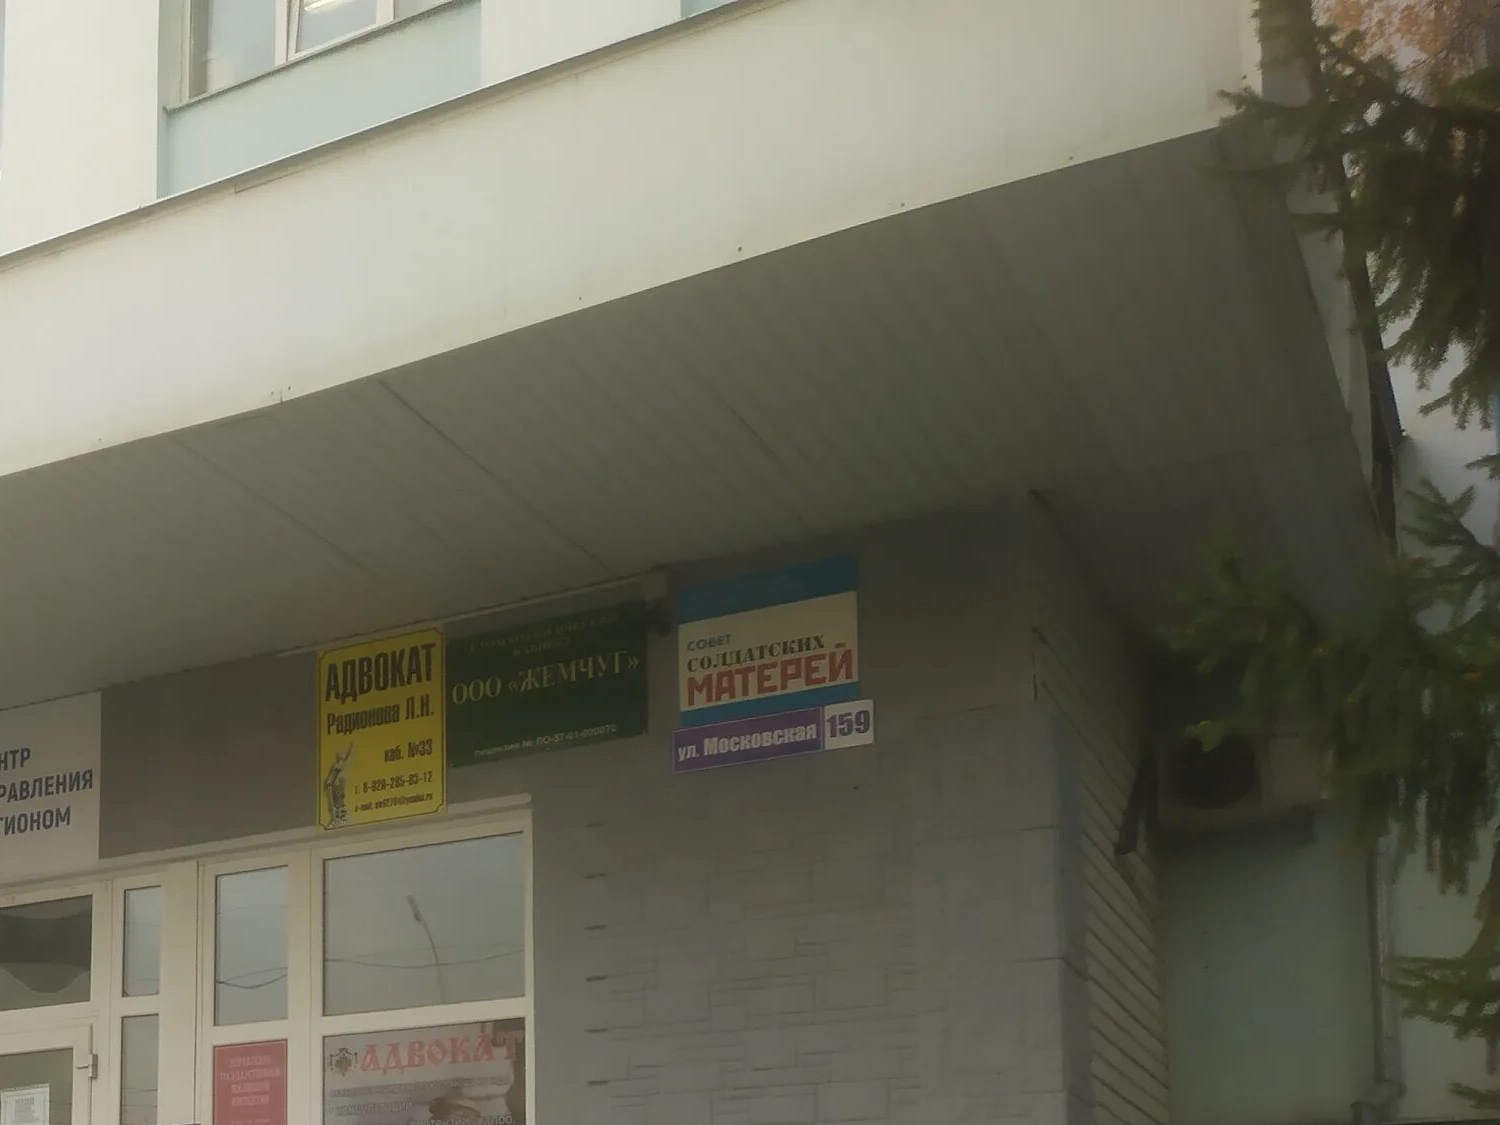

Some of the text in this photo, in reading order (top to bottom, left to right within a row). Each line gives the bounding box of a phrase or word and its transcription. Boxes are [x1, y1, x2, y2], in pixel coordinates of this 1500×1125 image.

[686, 634, 733, 652] СОВЕТ
[687, 633, 826, 673] СОЛДАТСКИХ
[324, 642, 437, 704] АДВОКАТ
[451, 649, 641, 705] ООО «ЖЕМЧУГ»
[687, 641, 854, 707] МАТЕРЕЙ
[326, 694, 435, 735] Радионова Л.Н.
[677, 709, 871, 763] ул. Московская 159
[359, 1031, 525, 1076] АДВОКАТ
